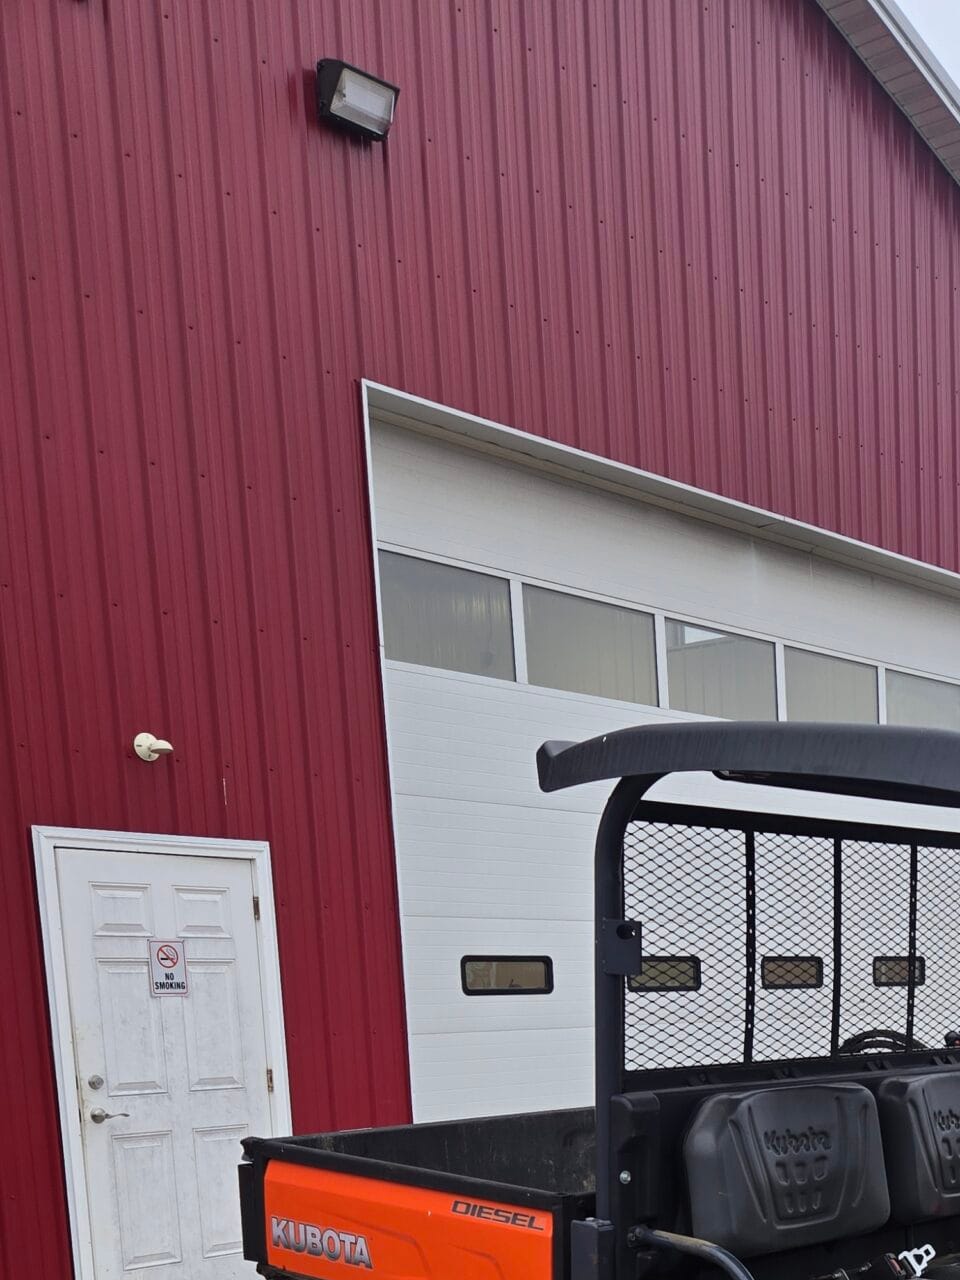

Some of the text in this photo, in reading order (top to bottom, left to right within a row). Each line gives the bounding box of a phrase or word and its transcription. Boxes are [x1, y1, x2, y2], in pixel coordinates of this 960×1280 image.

[155, 982, 185, 990] SMOKING
[164, 973, 174, 981] NO
[763, 1126, 832, 1156] Kubota
[451, 1200, 544, 1231] DIESEL
[271, 1216, 373, 1269] KUBOTA
